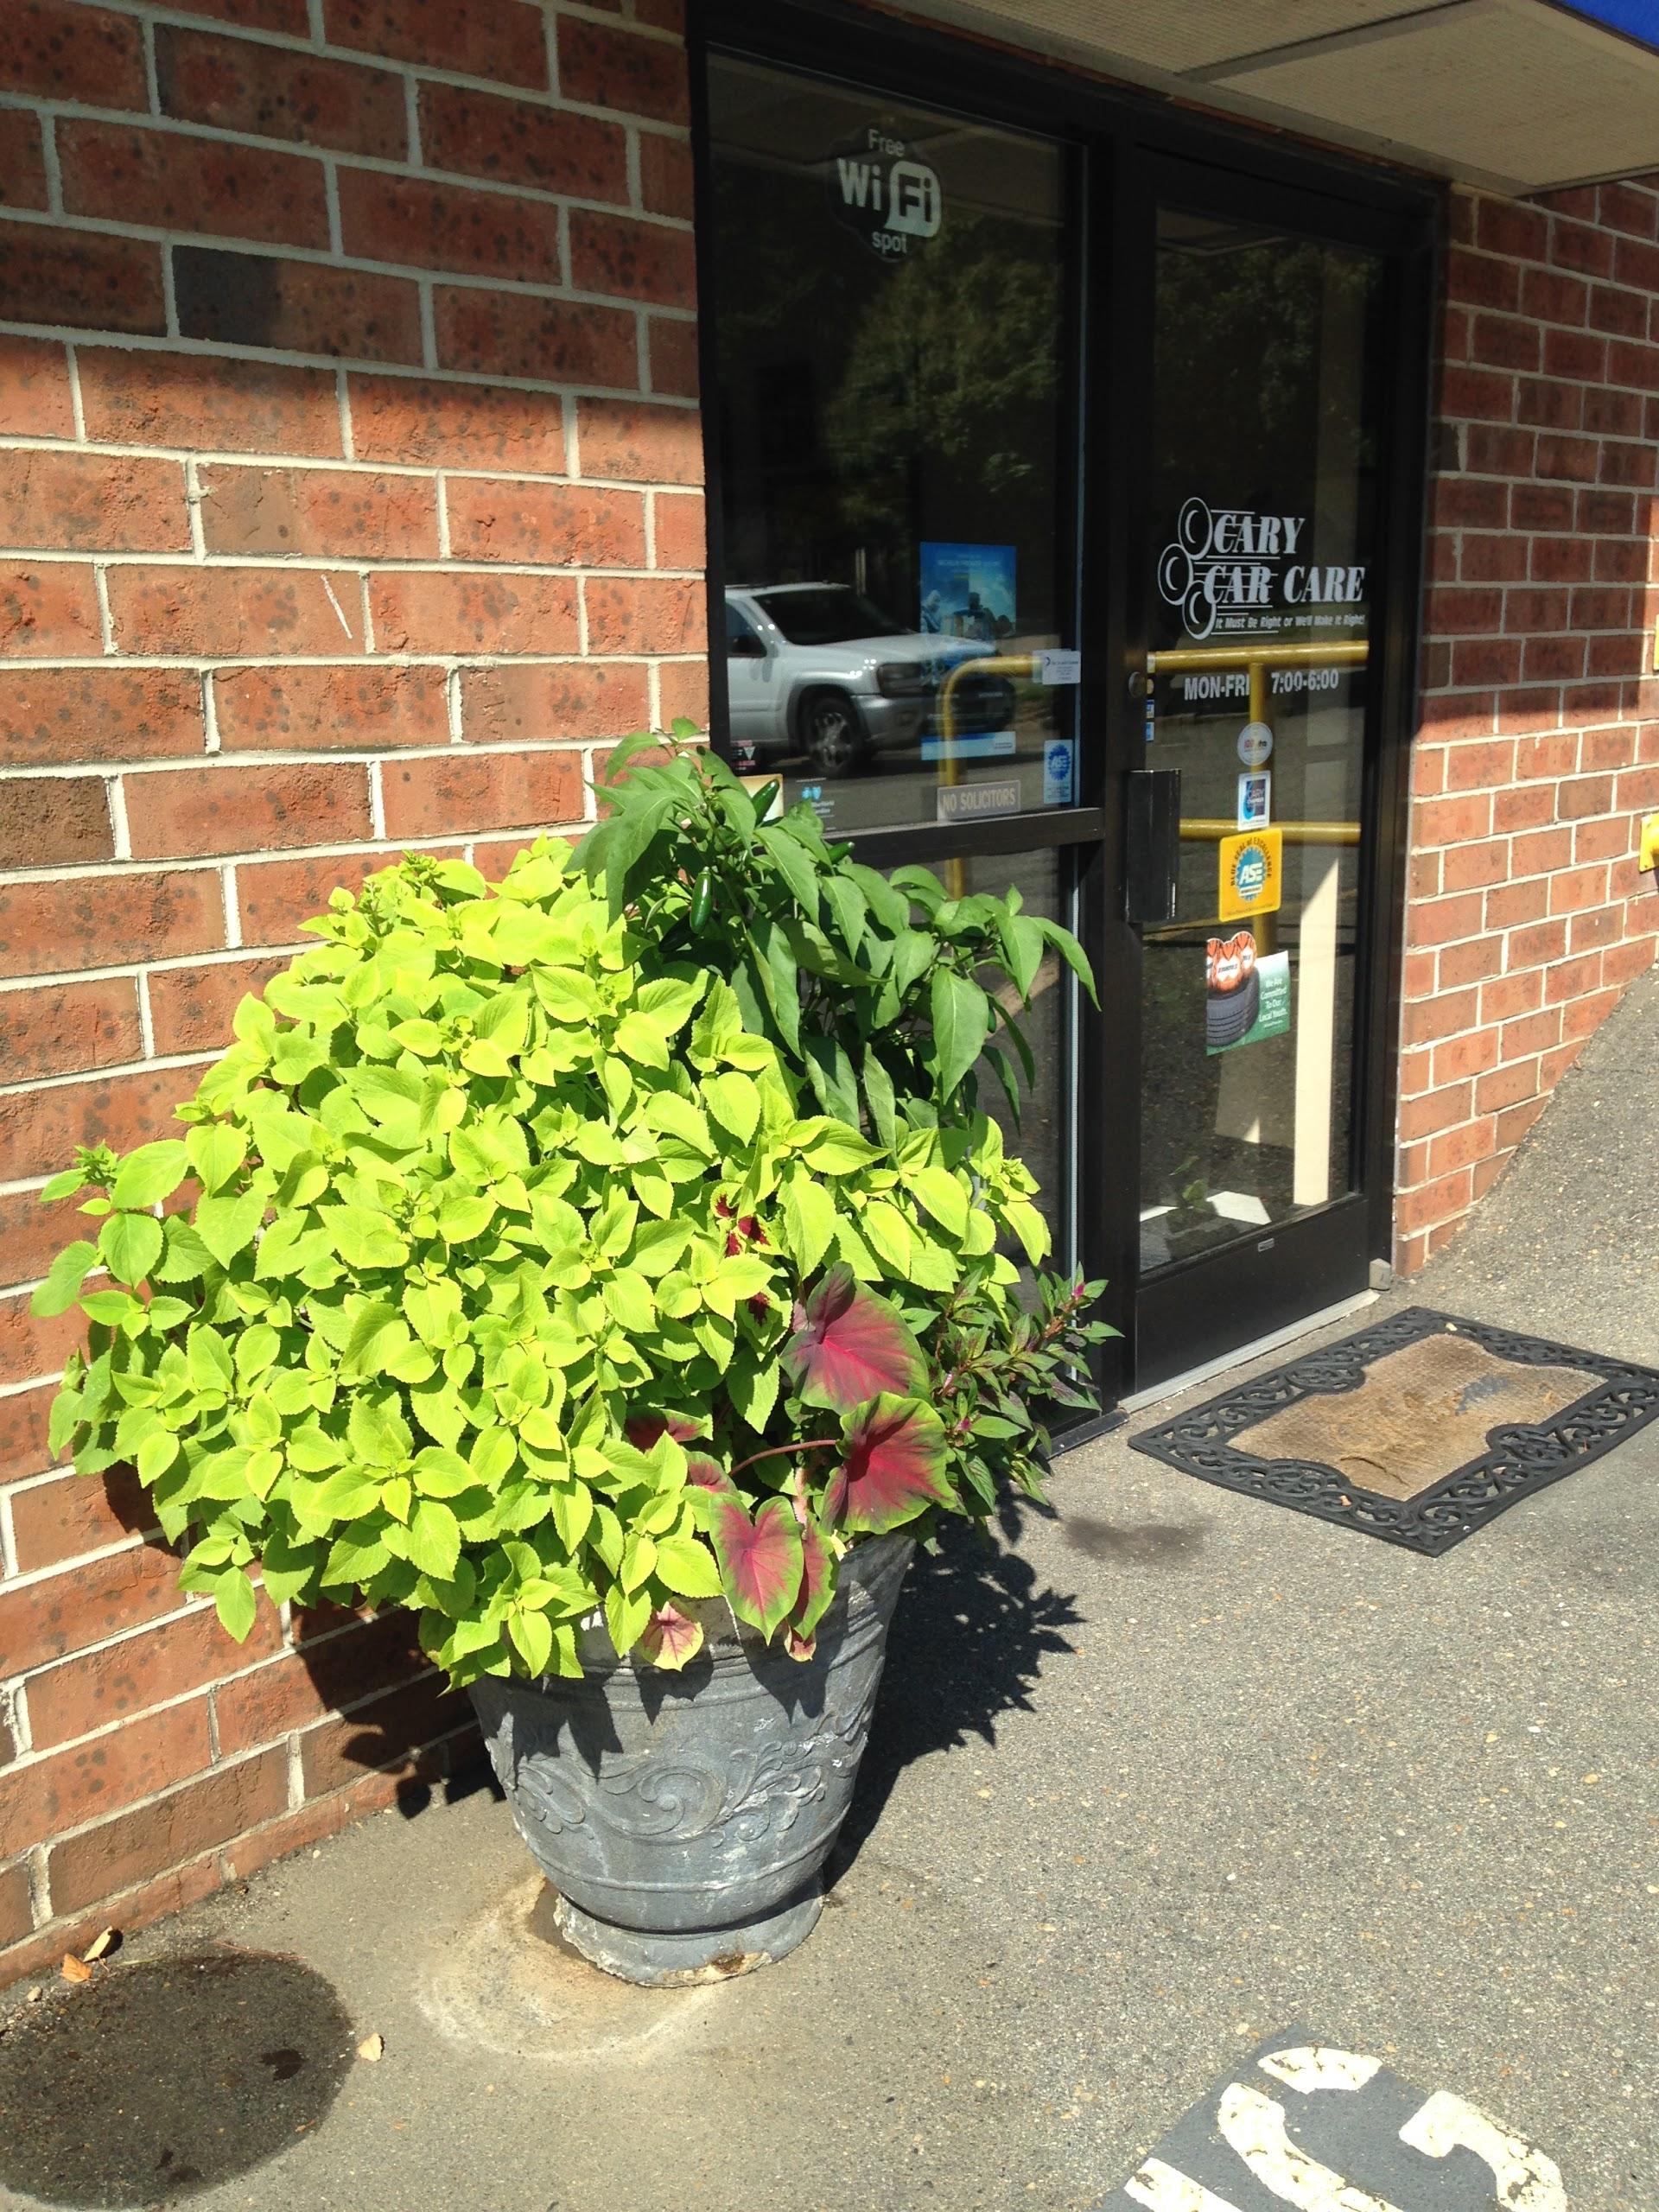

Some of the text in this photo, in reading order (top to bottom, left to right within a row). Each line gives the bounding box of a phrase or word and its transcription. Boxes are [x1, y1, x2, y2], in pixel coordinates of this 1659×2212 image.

[868, 129, 906, 157] Free
[872, 231, 907, 254] spot
[1213, 513, 1306, 555] CARY
[1203, 564, 1365, 605] CAR CARE
[1224, 616, 1245, 628] Must
[1247, 617, 1258, 628] Be
[1260, 615, 1282, 630] Right
[1283, 617, 1294, 627] or
[1313, 614, 1334, 626] Make
[1184, 668, 1339, 701] MON-FRI 7:00-6:00
[941, 787, 1015, 812] NO SOLICITORS
[1238, 862, 1263, 885] ASE
[1260, 986, 1287, 1001] Committed
[1259, 1010, 1273, 1022] Local
